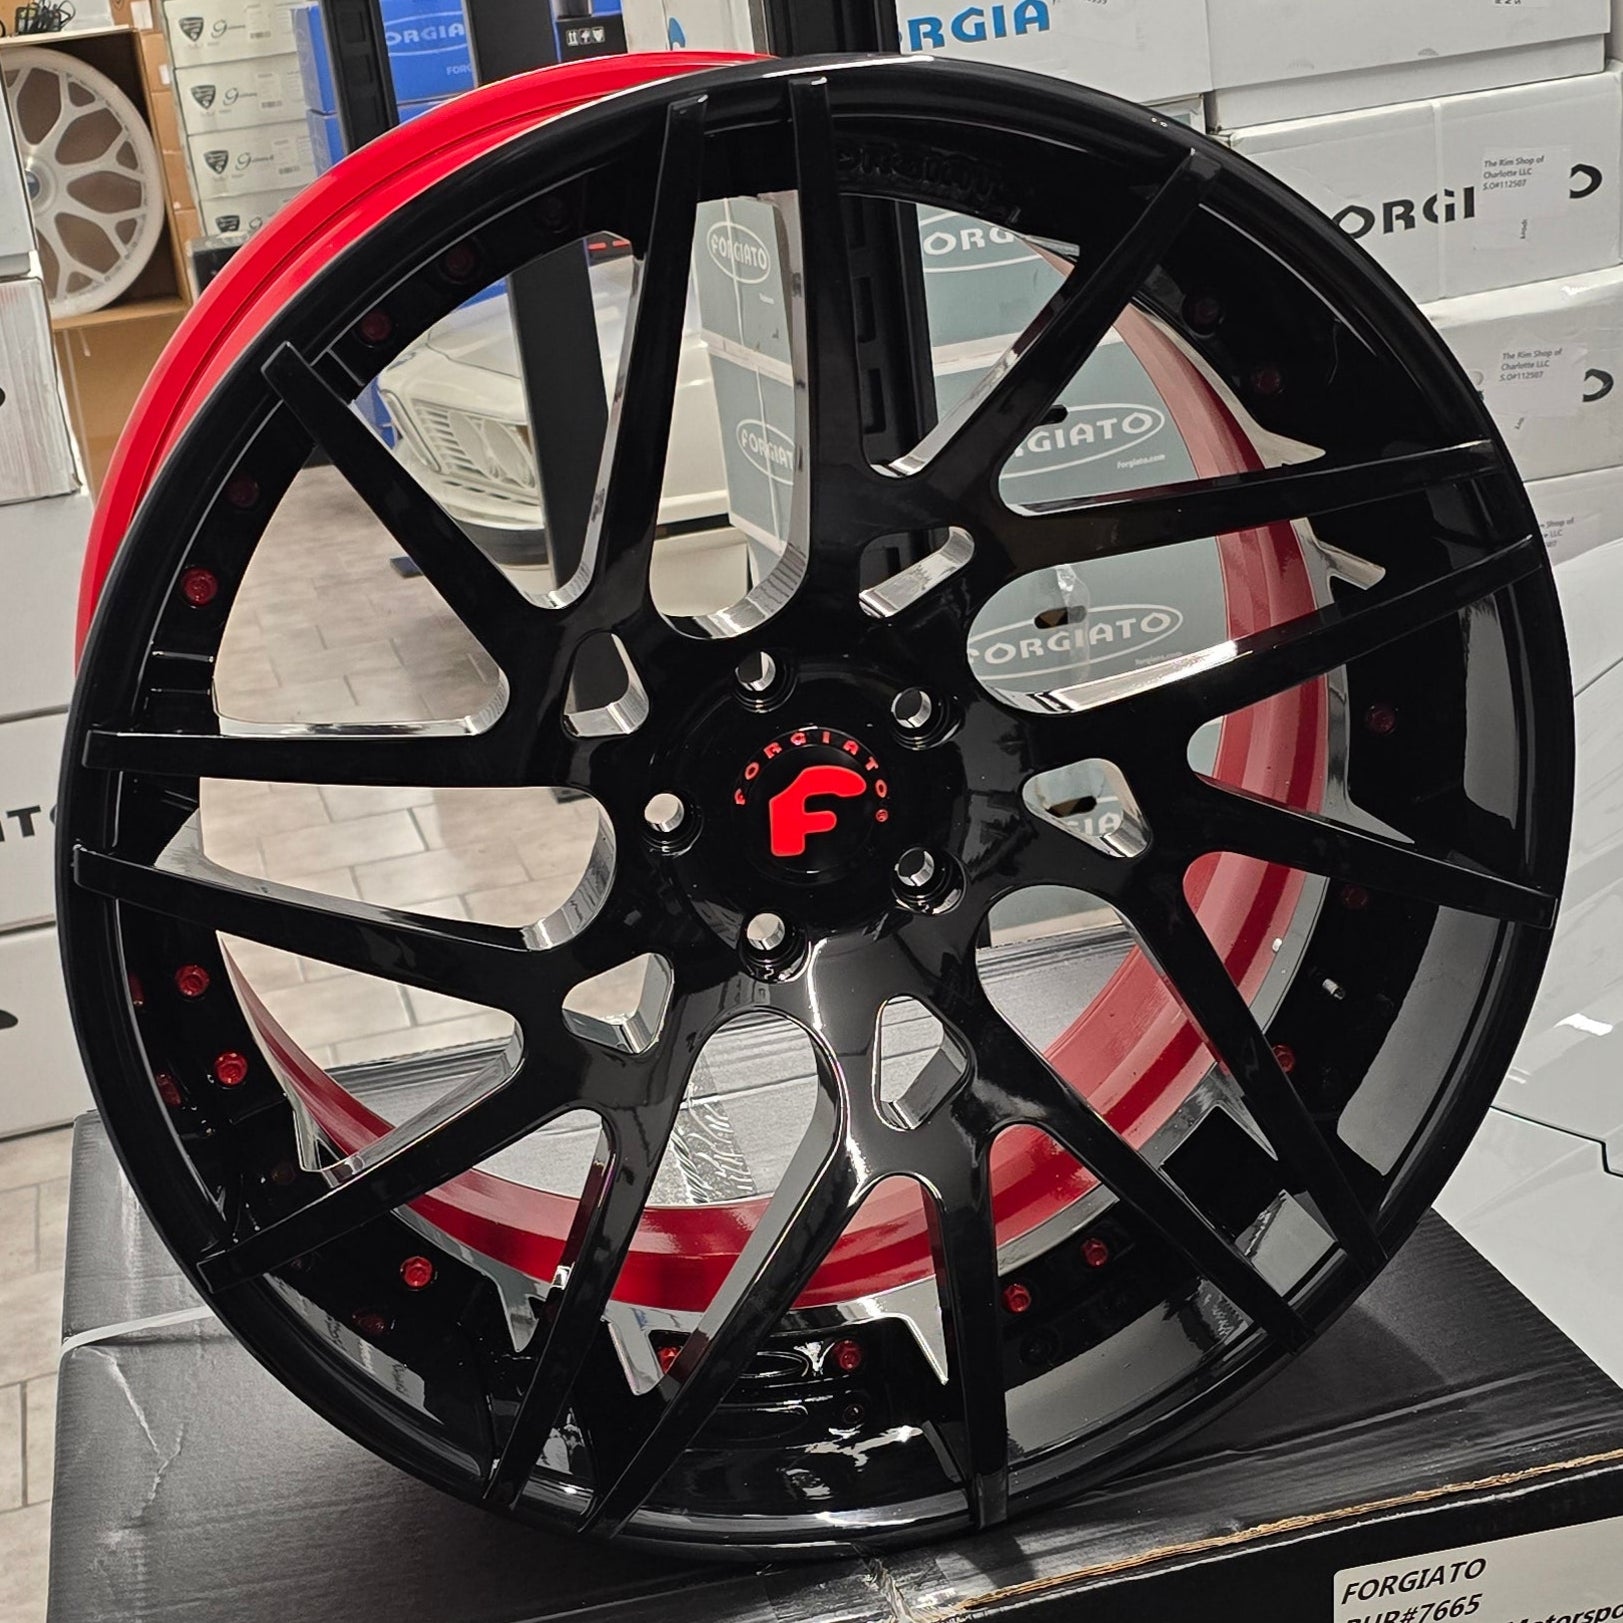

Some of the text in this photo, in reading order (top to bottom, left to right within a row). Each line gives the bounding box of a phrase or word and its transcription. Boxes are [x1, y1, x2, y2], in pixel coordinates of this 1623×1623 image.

[385, 23, 465, 46] ORGIA
[899, 0, 1050, 51] RGIA
[1483, 168, 1532, 179] Charlotte LLC
[1515, 157, 1534, 165] Shop
[710, 234, 768, 271] FORGIATO
[1501, 360, 1550, 371] Charlotte LLC
[1534, 350, 1553, 358] Shop
[741, 428, 794, 471] FORGIAT
[1014, 411, 1152, 458] GIATO
[734, 731, 887, 805] FORGIATO
[769, 765, 867, 856] F
[1341, 1558, 1486, 1604] FORGIATO
